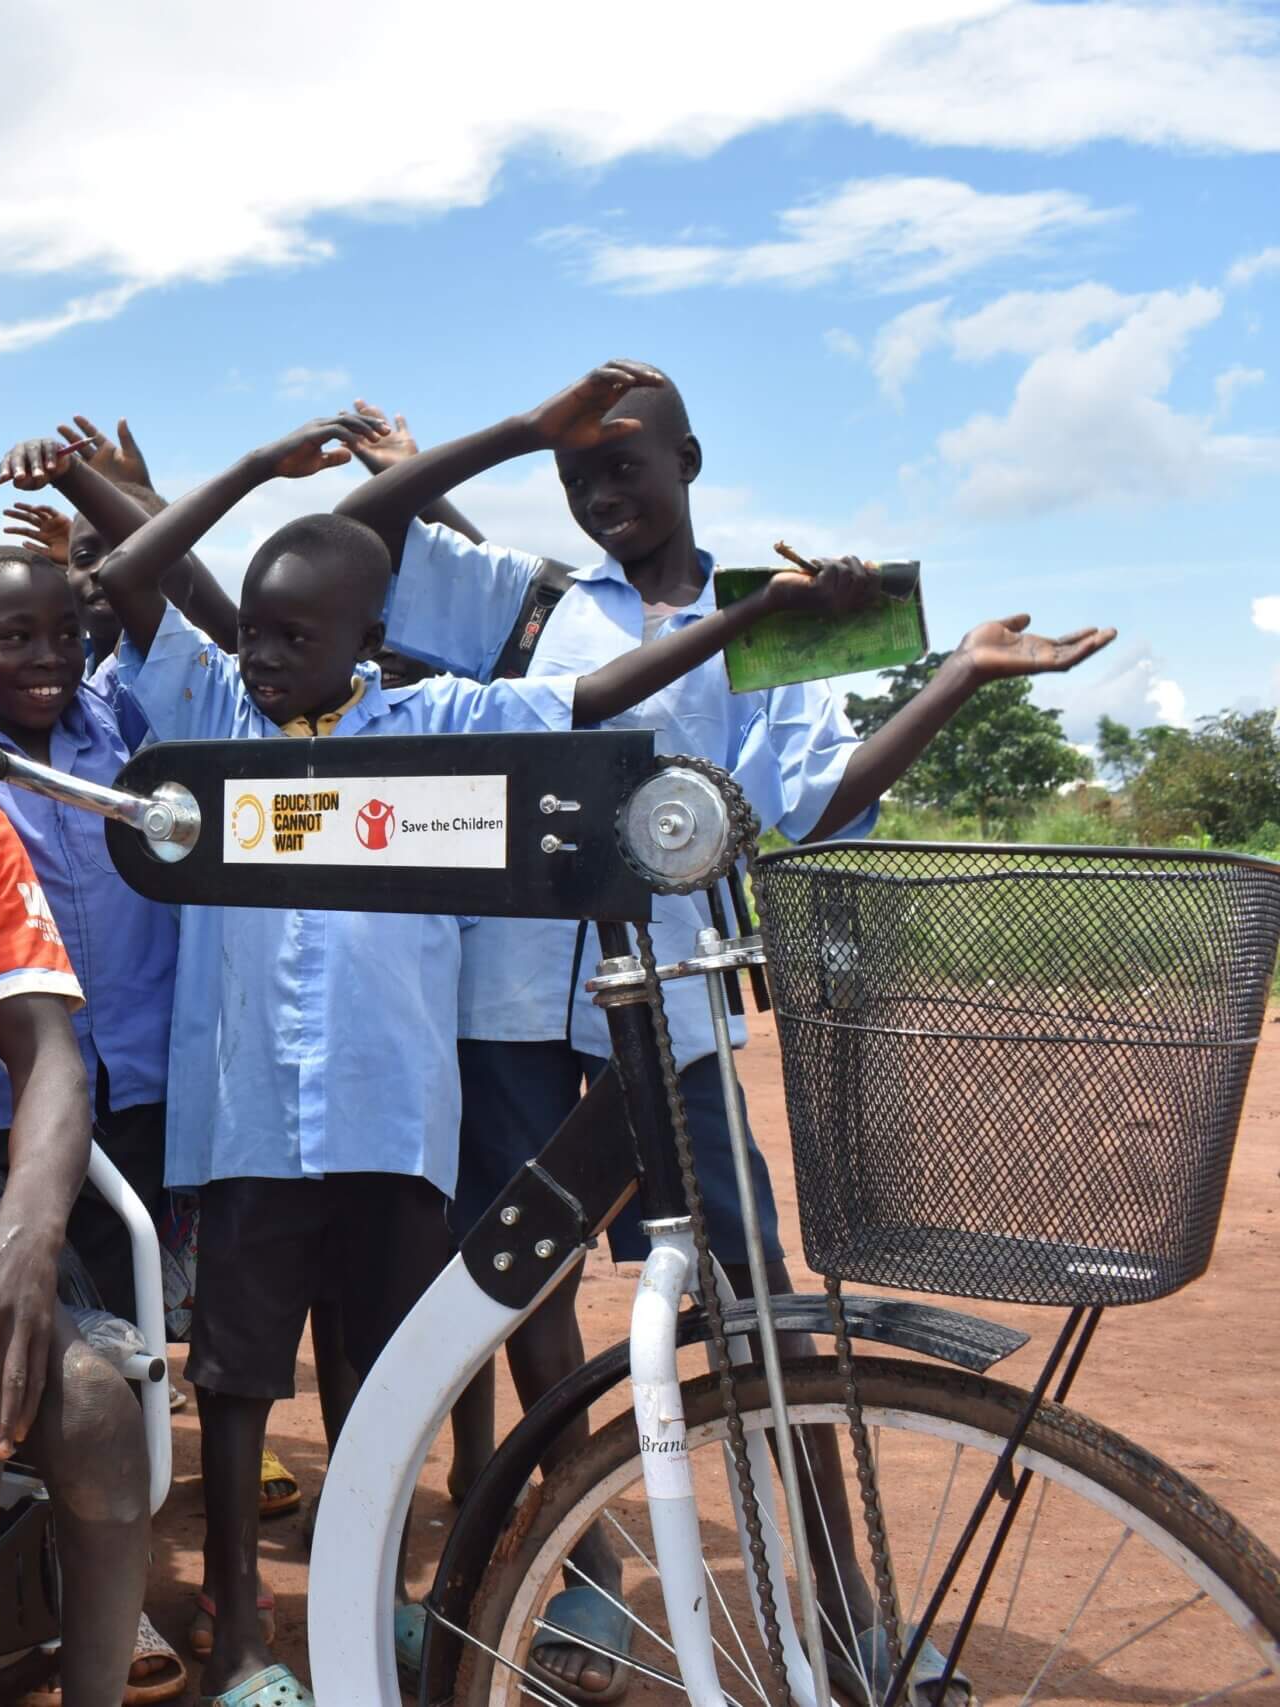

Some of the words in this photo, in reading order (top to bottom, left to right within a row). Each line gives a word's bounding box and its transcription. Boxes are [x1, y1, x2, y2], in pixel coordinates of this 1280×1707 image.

[274, 792, 339, 811] EDUCATION
[274, 813, 322, 832] CANNOT
[401, 820, 428, 832] Save
[431, 819, 450, 831] the
[452, 817, 503, 831] Children
[274, 834, 304, 851] WAIT
